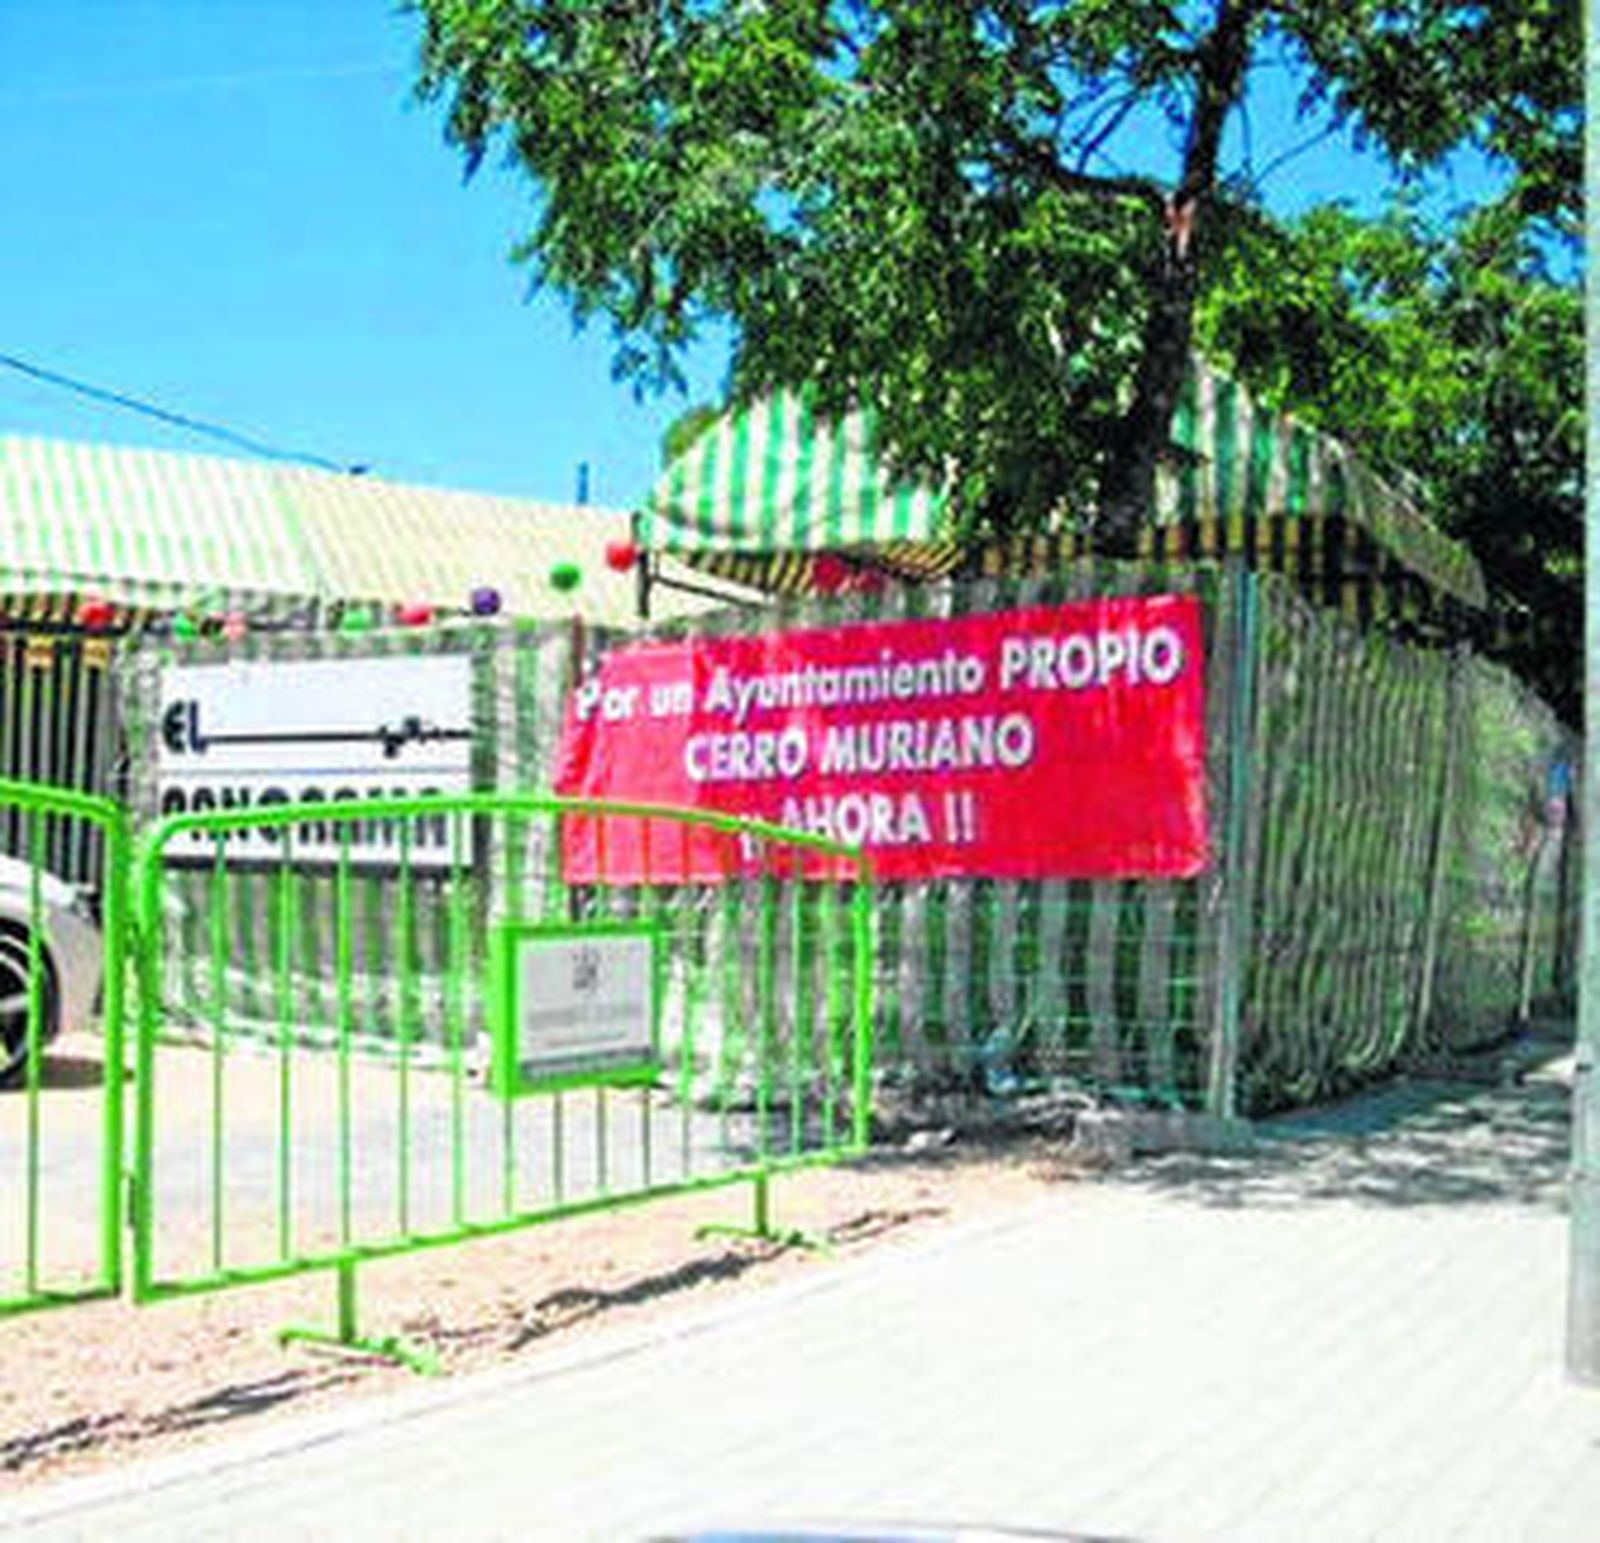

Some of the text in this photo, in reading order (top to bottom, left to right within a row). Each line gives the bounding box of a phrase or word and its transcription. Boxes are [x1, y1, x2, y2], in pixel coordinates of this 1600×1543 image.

[575, 627, 1184, 727] Por un Ayuntamiento PROPIO
[684, 712, 1035, 782] CERRO MURIANO
[780, 792, 932, 847] AHORA
